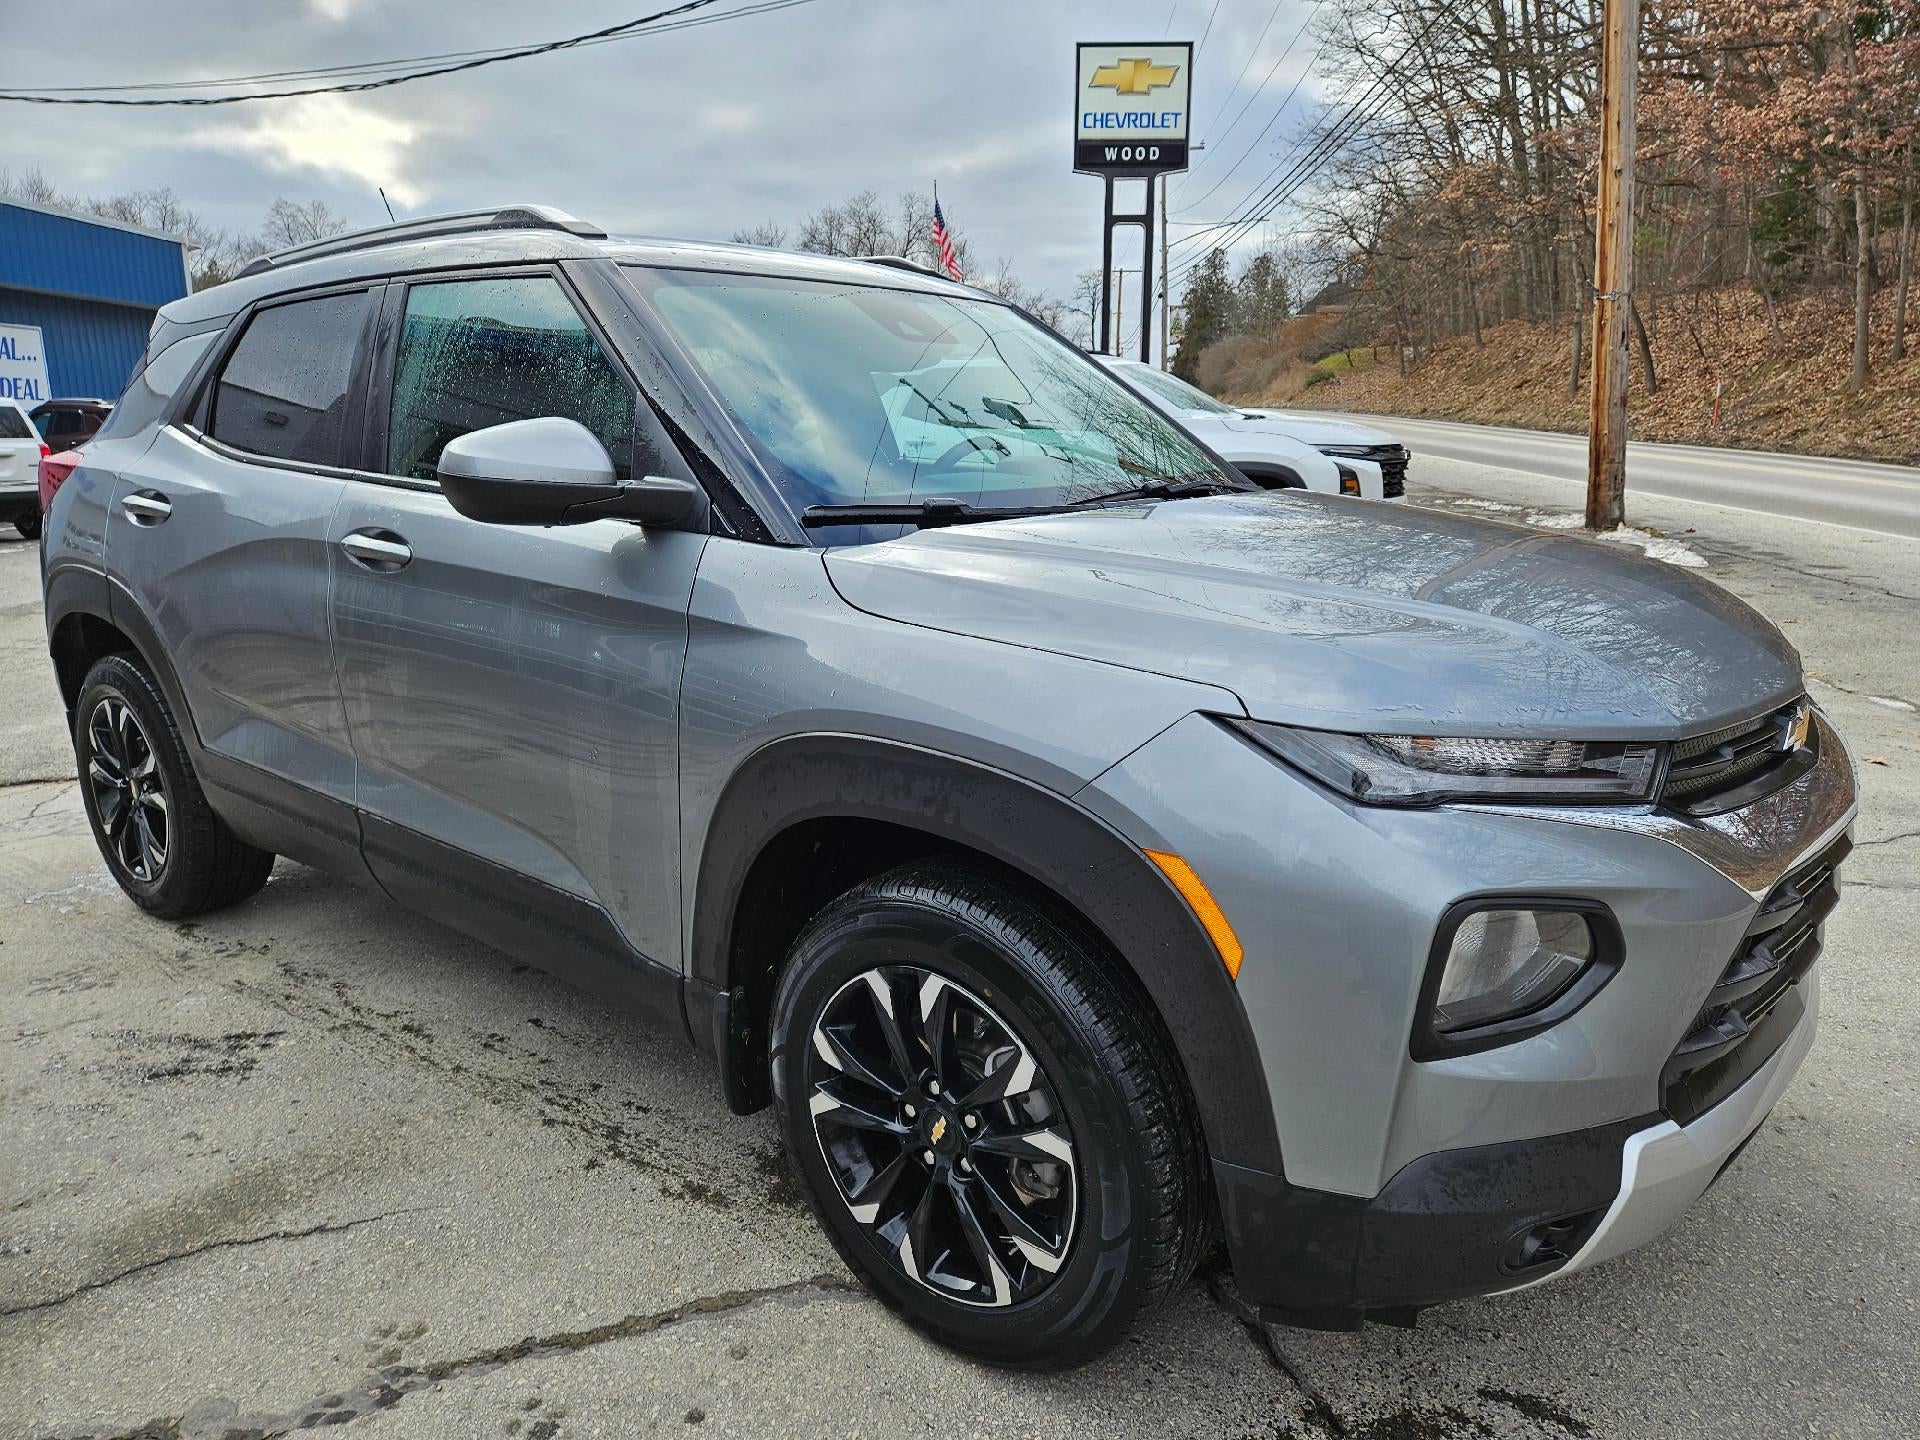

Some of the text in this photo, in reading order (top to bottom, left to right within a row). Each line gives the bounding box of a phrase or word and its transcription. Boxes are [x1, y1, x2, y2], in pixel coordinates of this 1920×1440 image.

[1083, 112, 1182, 129] CHEVROLET
[1104, 146, 1160, 161] WOOD
[0, 377, 44, 400] DEAL
